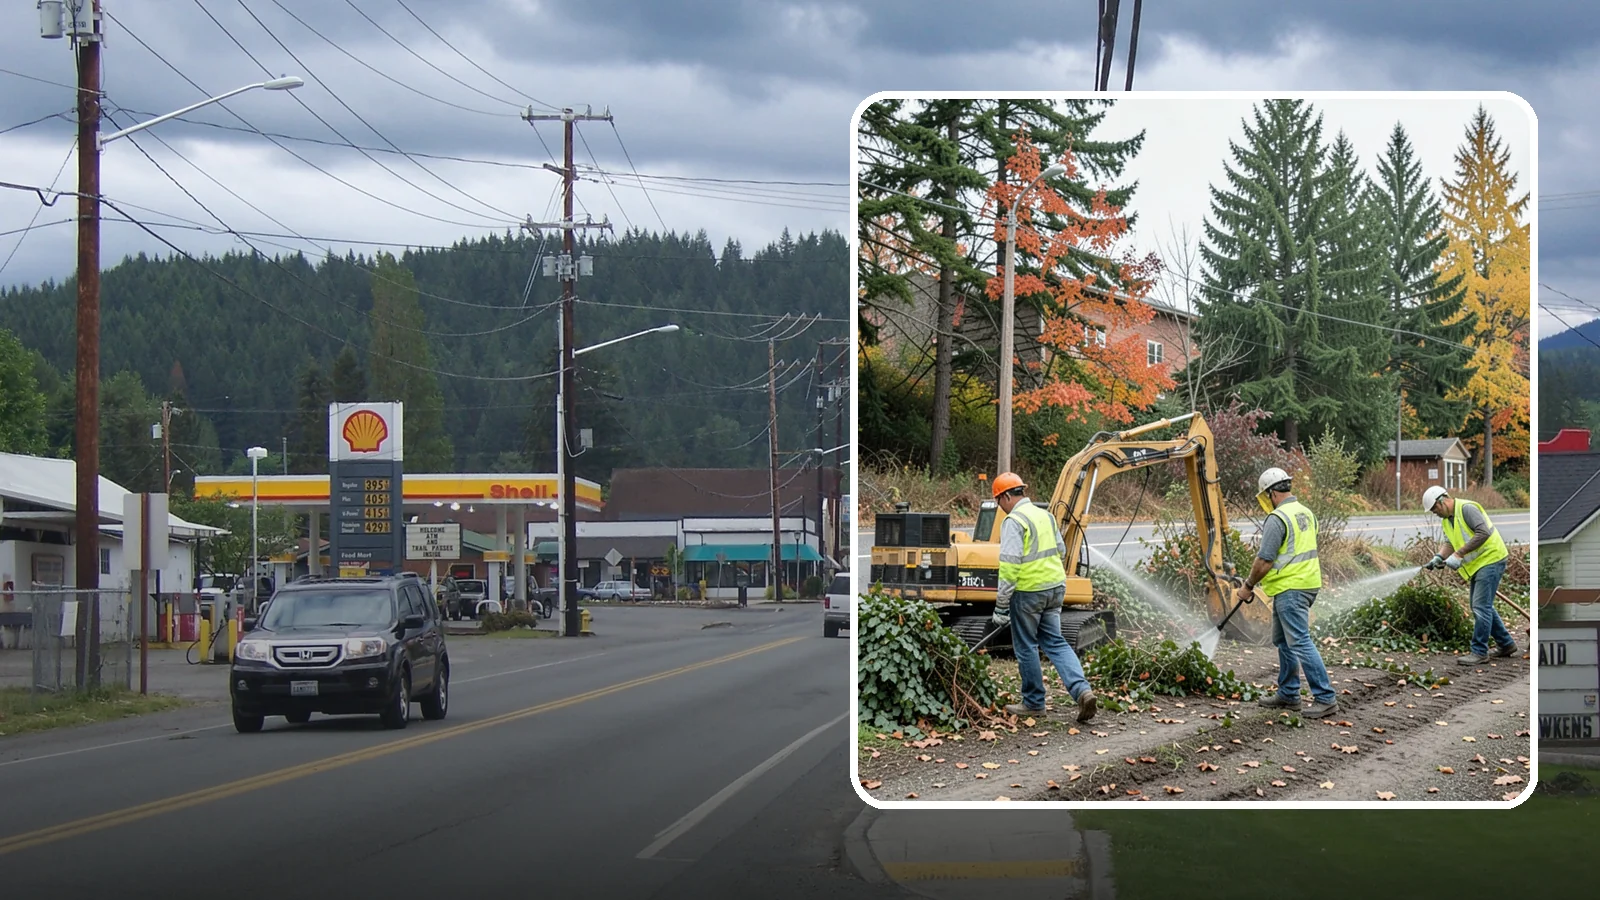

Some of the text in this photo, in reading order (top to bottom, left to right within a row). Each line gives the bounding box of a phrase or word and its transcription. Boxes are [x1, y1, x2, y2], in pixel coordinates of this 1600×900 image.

[366, 480, 384, 490] 395
[490, 484, 547, 499] Shell
[366, 494, 384, 504] 405
[366, 508, 384, 518] 415
[366, 522, 384, 533] 429
[1539, 643, 1567, 665] AID
